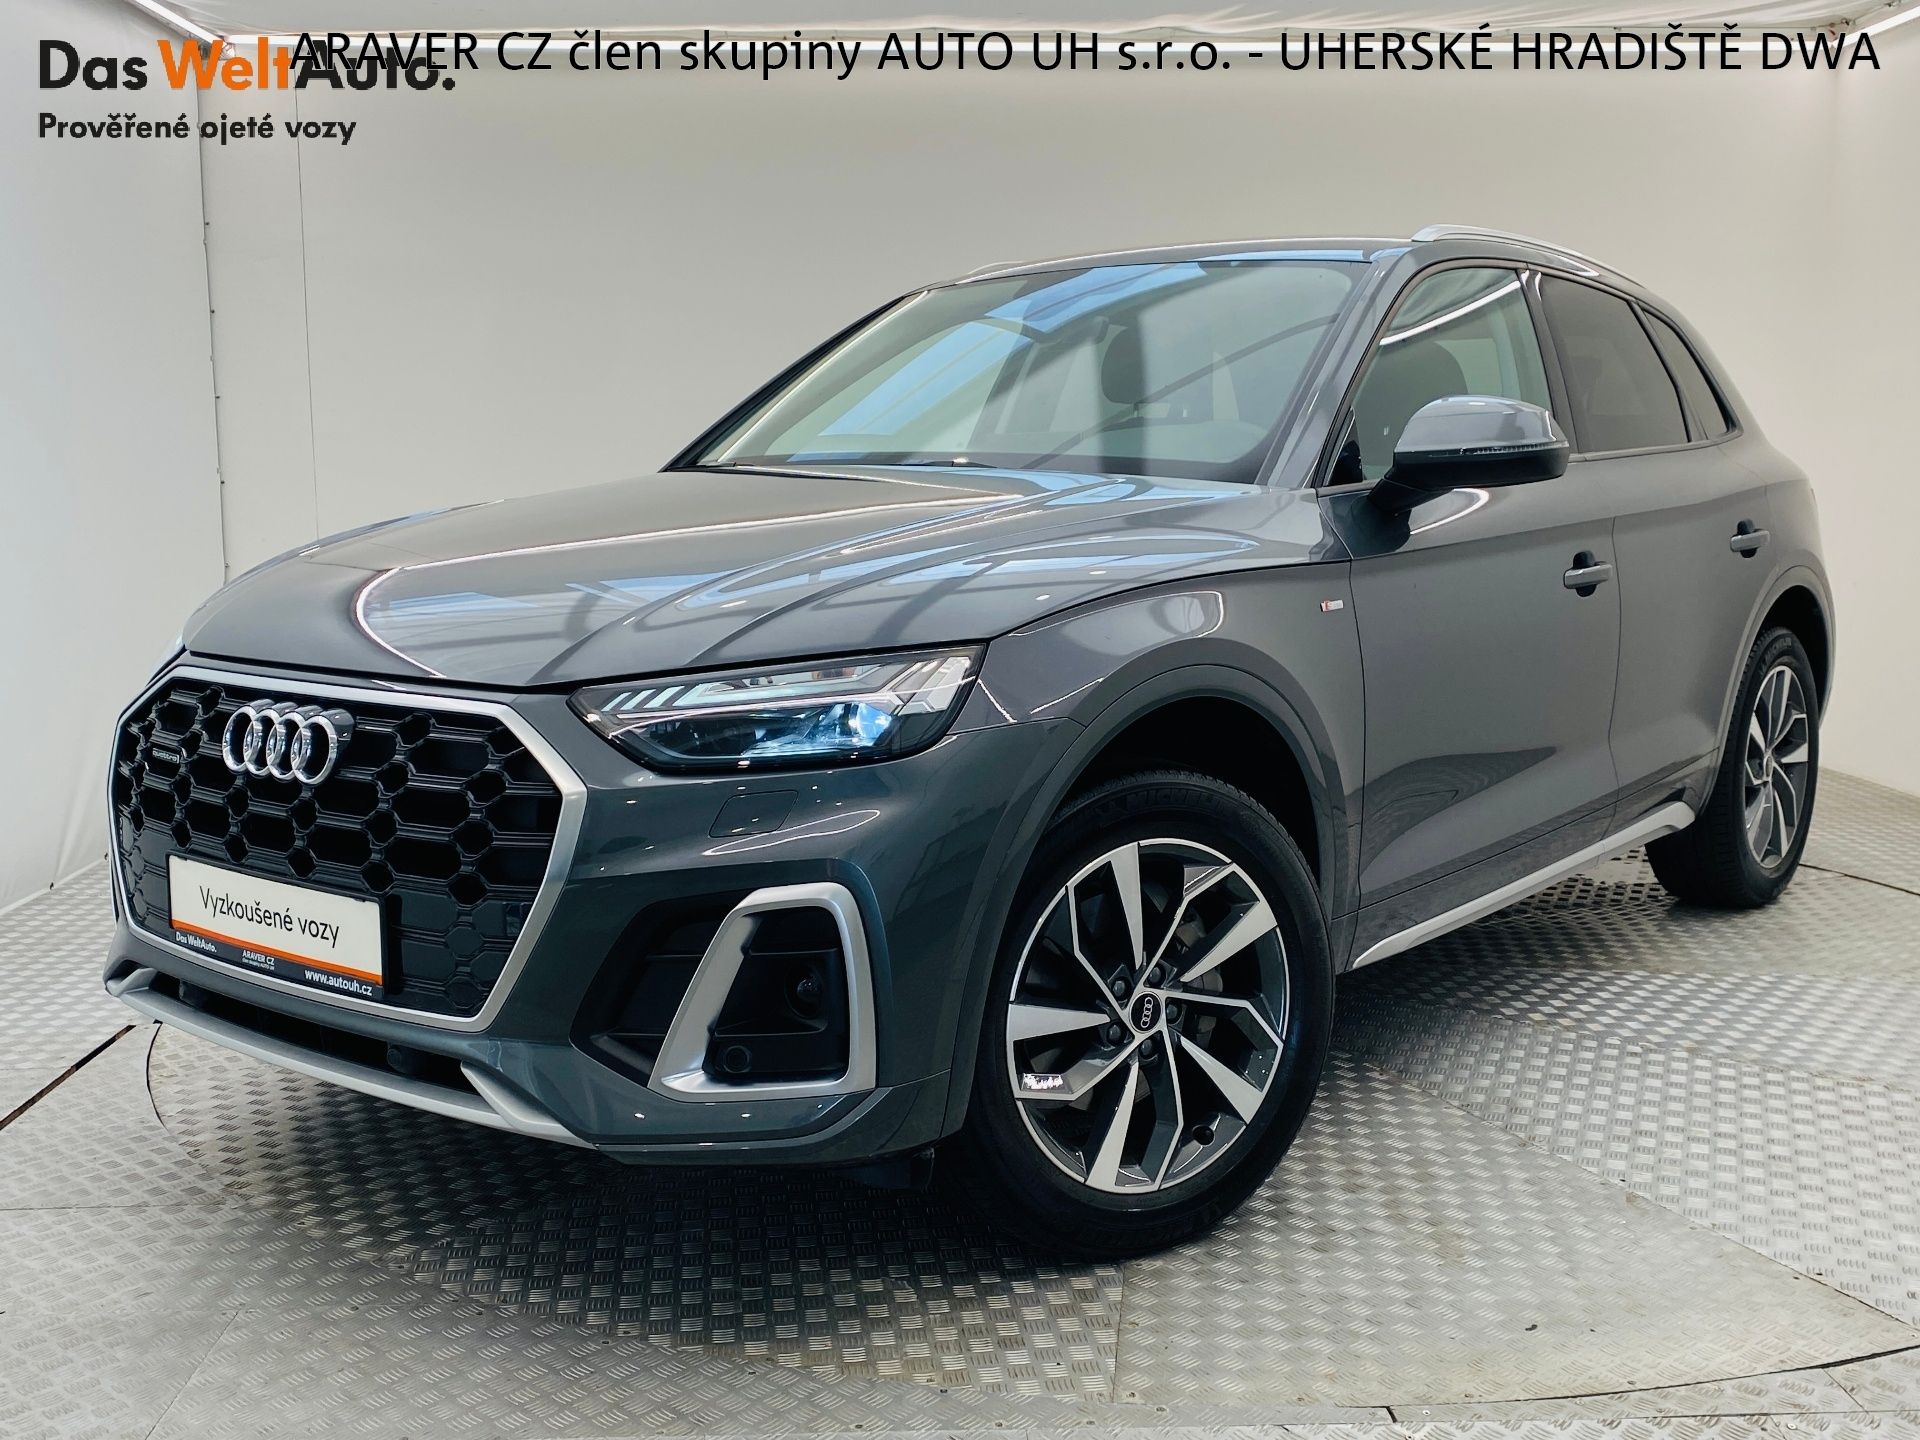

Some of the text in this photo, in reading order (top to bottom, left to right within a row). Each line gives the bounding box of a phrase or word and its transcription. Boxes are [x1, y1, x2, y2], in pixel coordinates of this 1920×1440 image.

[199, 885, 340, 949] Vyzkoušené vozy
[175, 931, 188, 944] Das
[242, 949, 266, 963] ARAVER
[266, 956, 275, 966] CZ
[304, 969, 373, 996] www.autouh.cz
